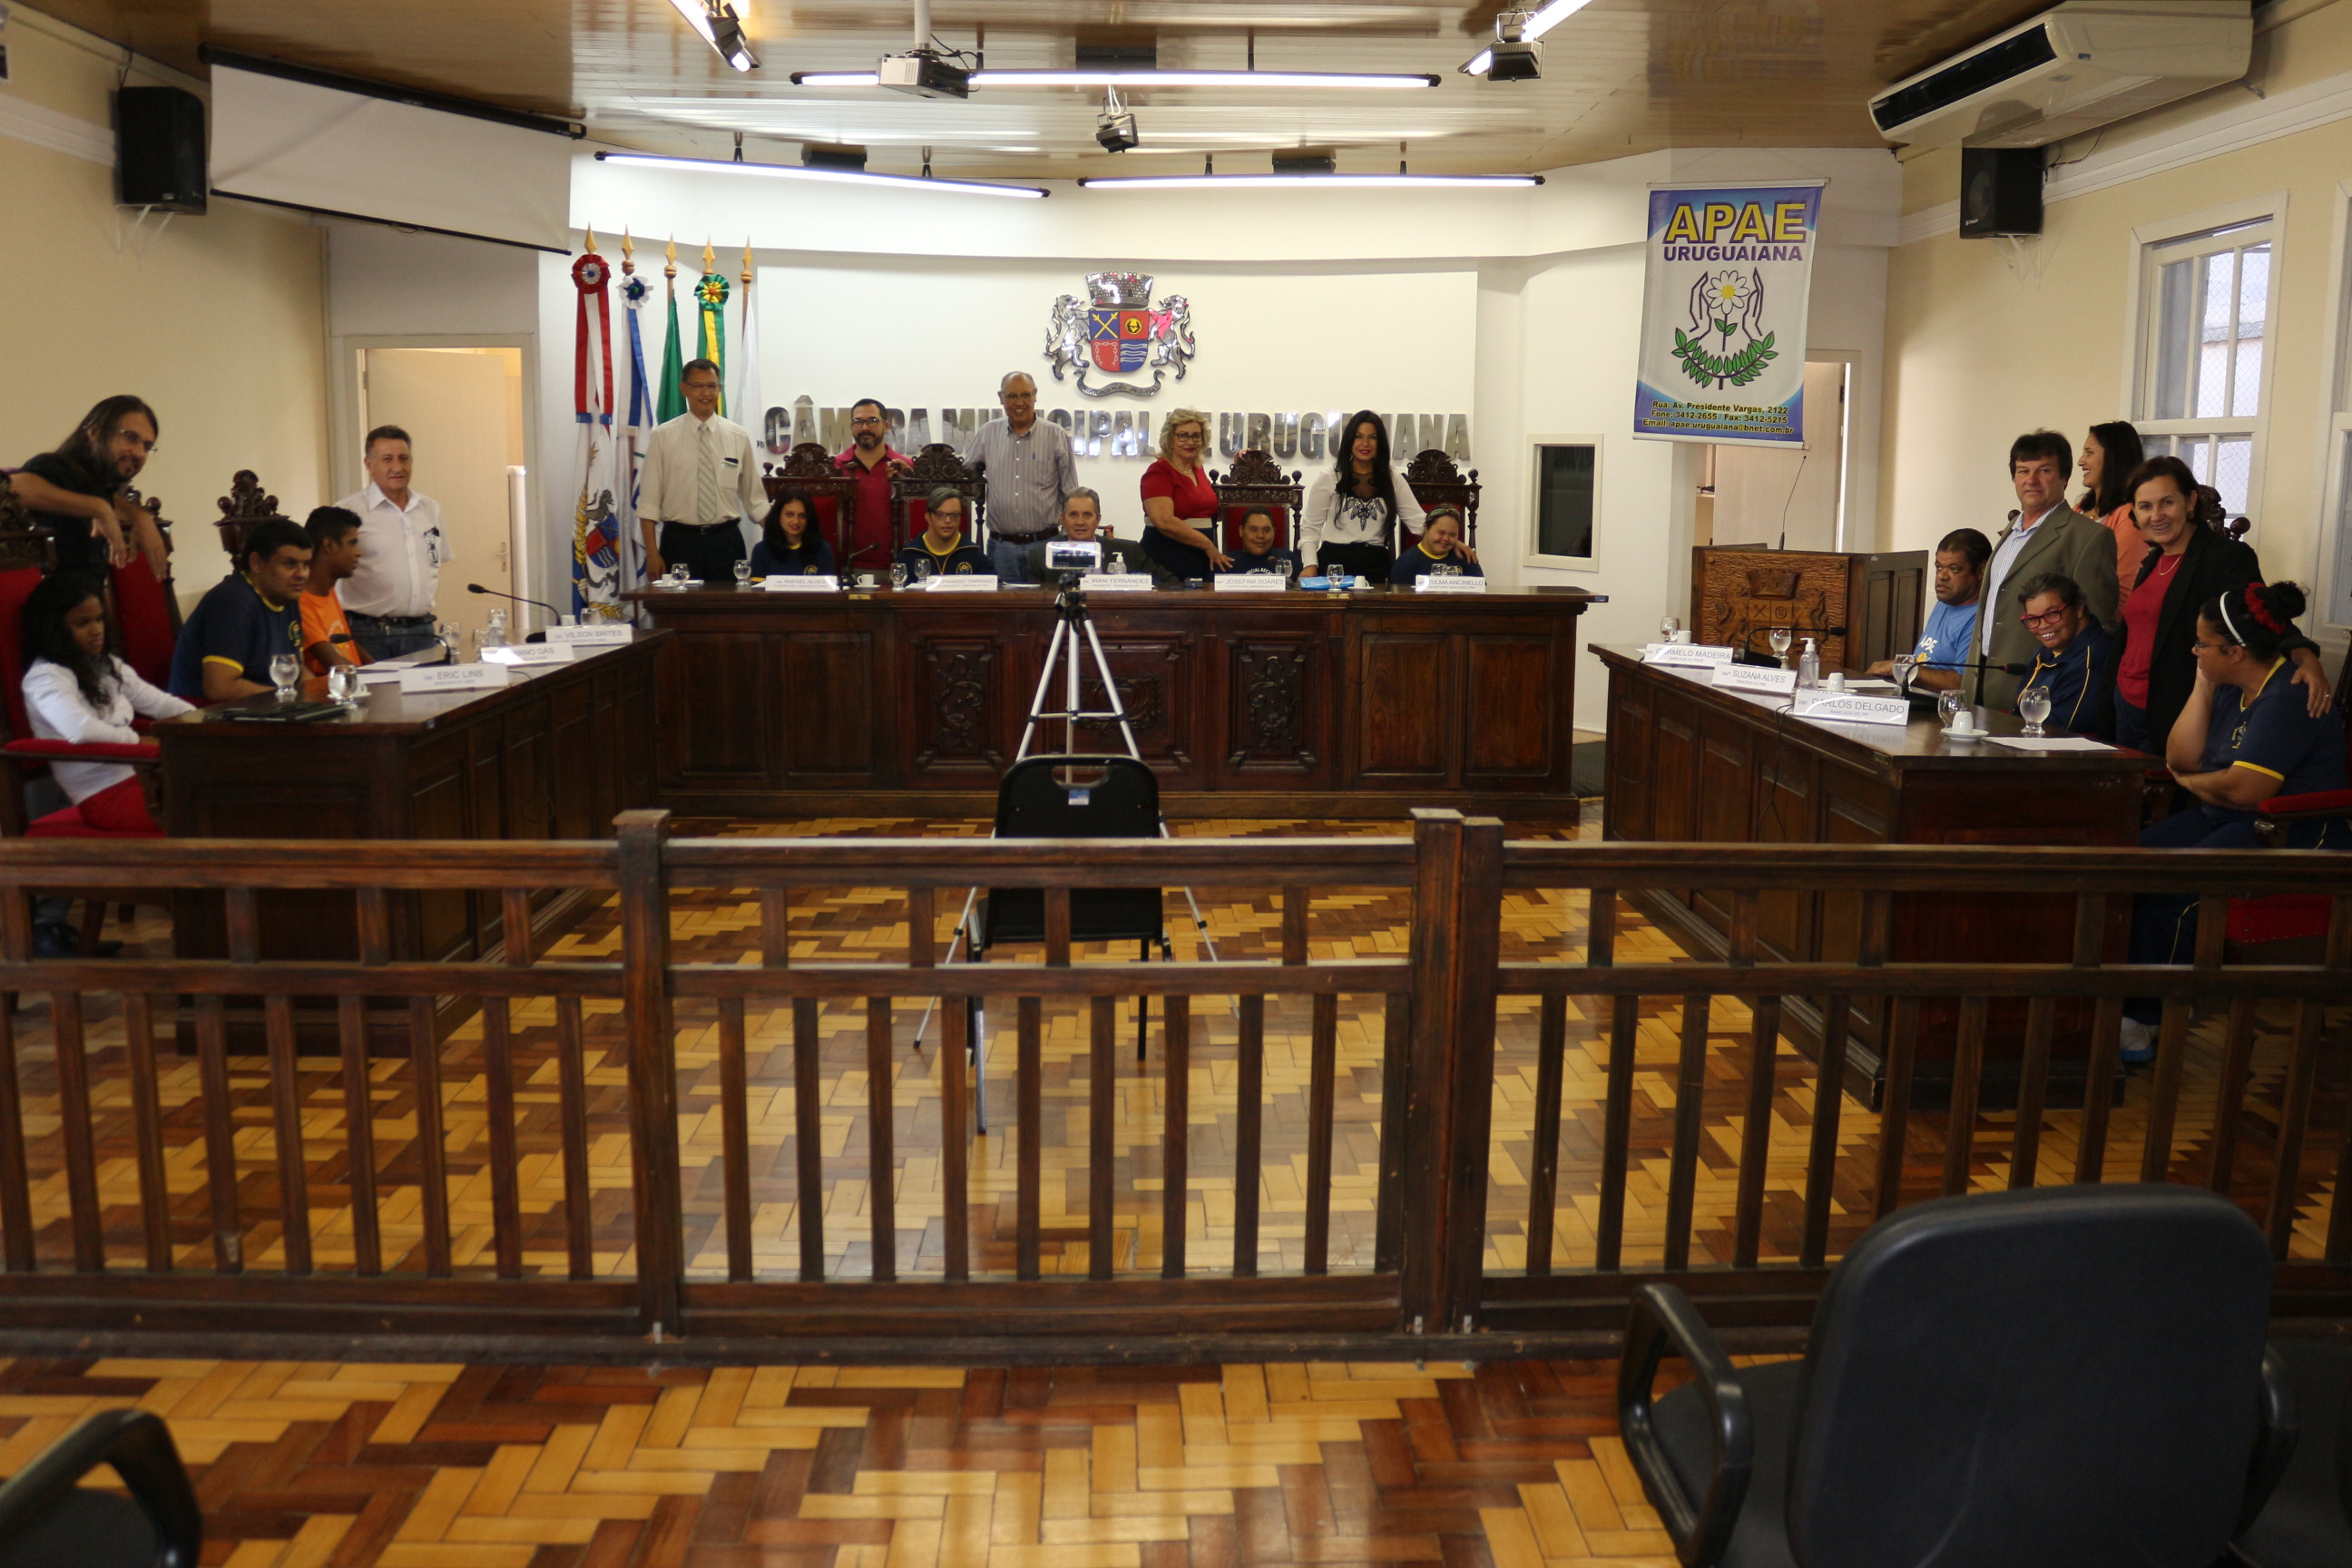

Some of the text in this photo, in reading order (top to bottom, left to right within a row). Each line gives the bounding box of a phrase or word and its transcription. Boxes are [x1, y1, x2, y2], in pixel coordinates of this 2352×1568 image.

[1662, 201, 1807, 244] APAE
[1663, 245, 1804, 261] URUGUAIANA
[1672, 401, 1684, 409] Av.
[1687, 402, 1731, 412] Presidente
[1733, 404, 1765, 415] Vargas,
[1768, 407, 1788, 415] 2122
[1675, 411, 1718, 420] 3412-2655
[1724, 414, 1741, 422] Fax:
[1744, 415, 1788, 424] 3412-5215
[764, 394, 931, 456] CÂMRA
[1643, 419, 1794, 435] Email: apae.uruguaiana@bnet.com.br
[564, 631, 594, 639] VILSON
[1656, 648, 1693, 657] CRMELO
[1695, 650, 1731, 660] MADEIRA
[436, 671, 460, 680] ERIC
[462, 670, 484, 678] LINS
[1731, 670, 1761, 680] SUZANA
[1761, 672, 1787, 683] ALVES
[1811, 698, 1853, 709] CARLOS
[1855, 701, 1905, 714] DELGADO
